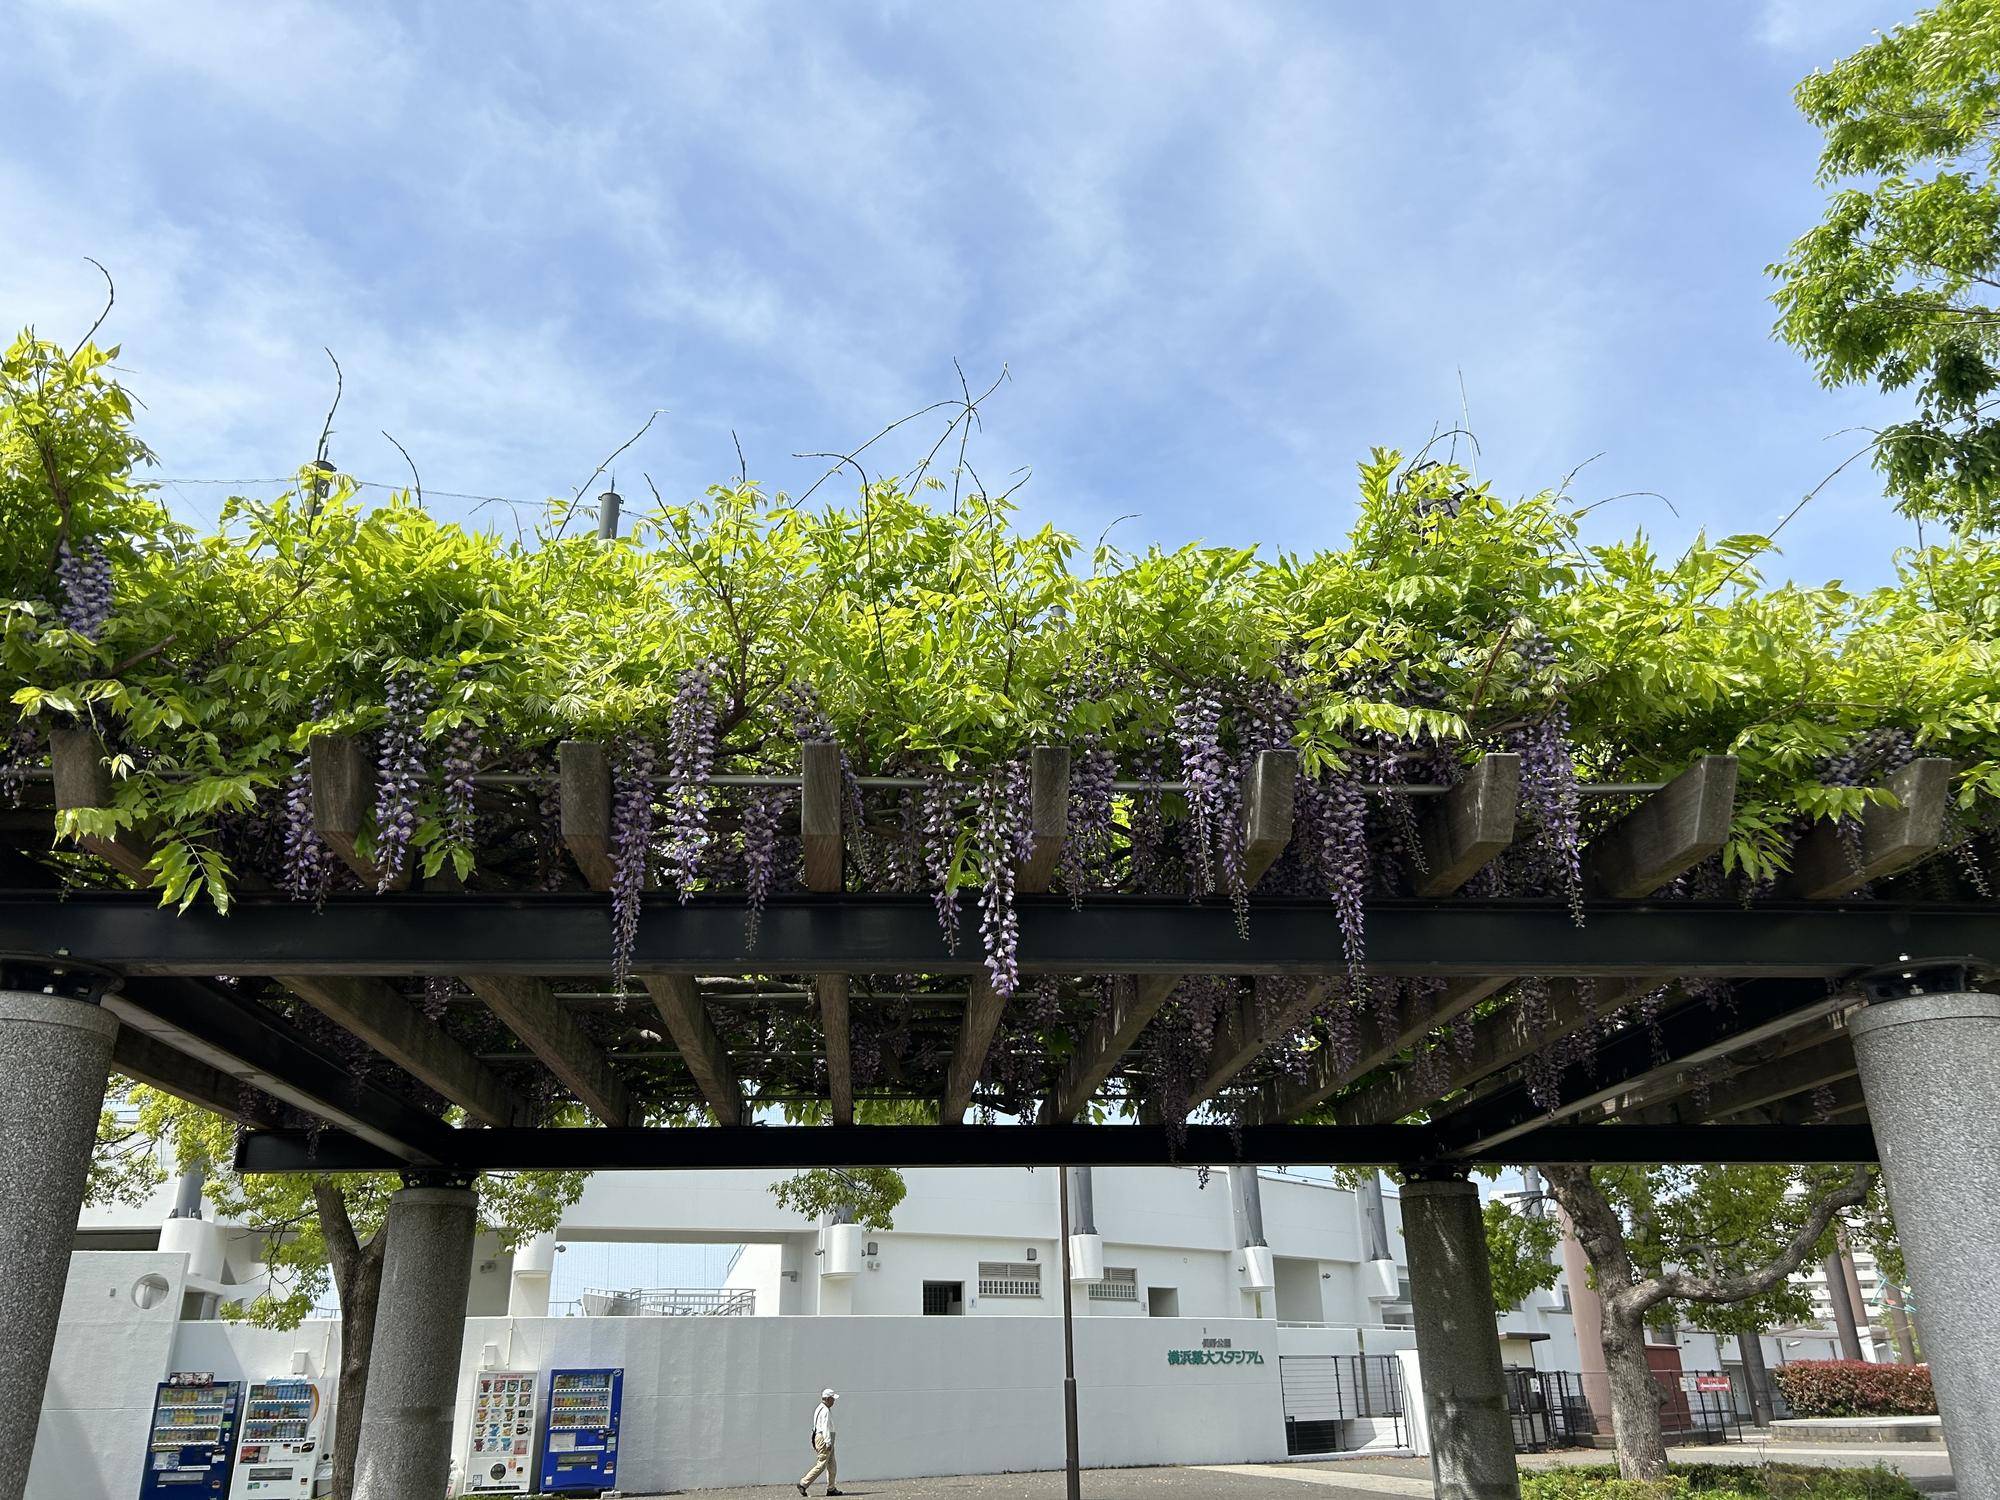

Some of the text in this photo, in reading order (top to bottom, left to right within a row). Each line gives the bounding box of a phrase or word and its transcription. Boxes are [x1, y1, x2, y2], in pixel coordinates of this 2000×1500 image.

[1168, 1350, 1264, 1365] 横浜薬大スタジアム
